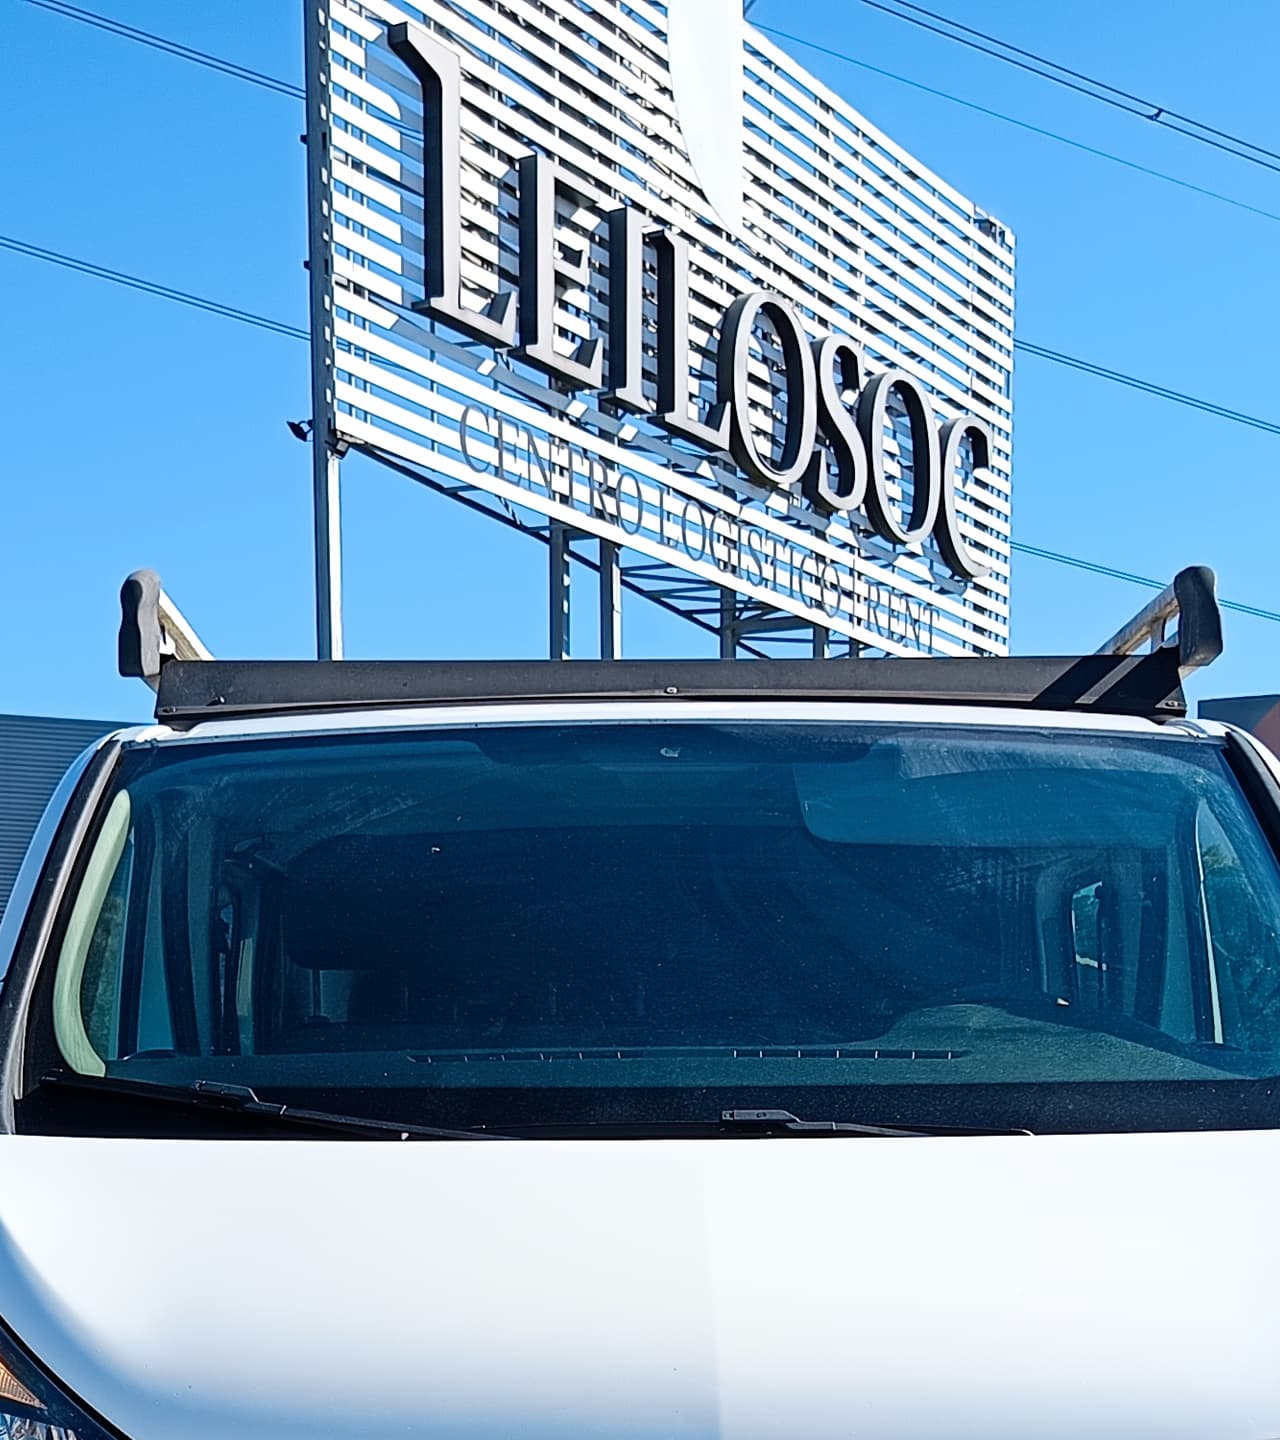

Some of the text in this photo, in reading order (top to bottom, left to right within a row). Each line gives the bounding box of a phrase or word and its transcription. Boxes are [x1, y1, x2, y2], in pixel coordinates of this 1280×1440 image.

[388, 22, 993, 580] LEILOSOC
[460, 404, 644, 536] CENTRO
[866, 580, 941, 655] RENT
